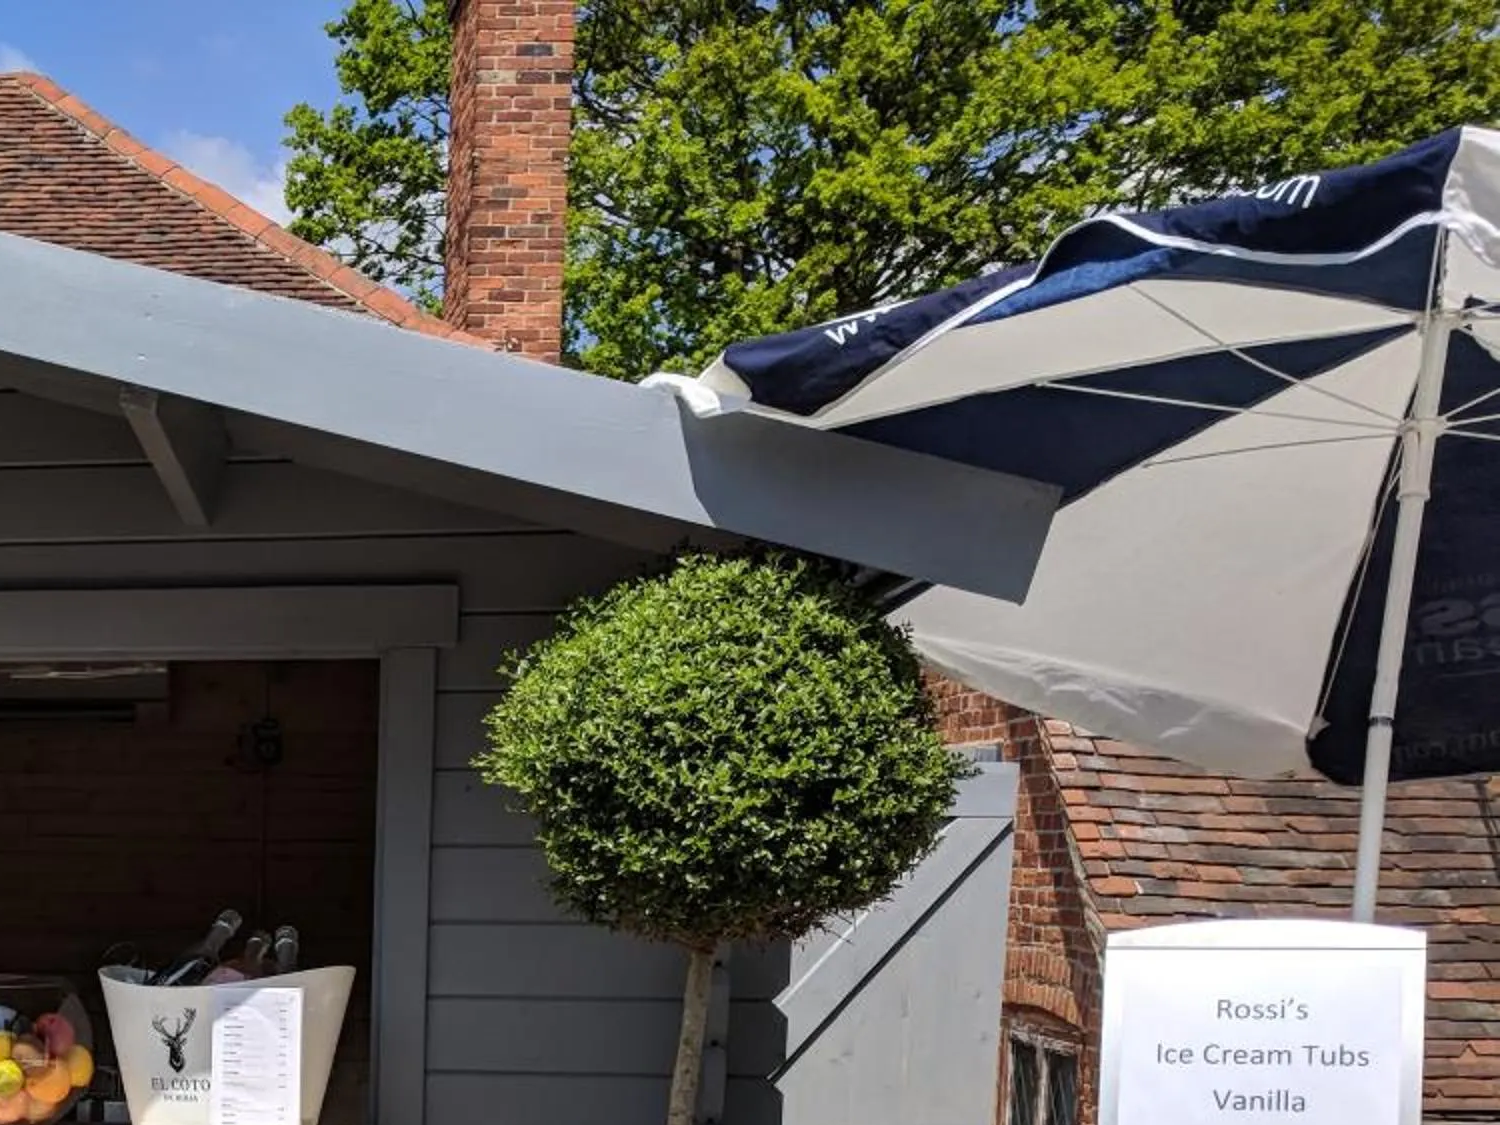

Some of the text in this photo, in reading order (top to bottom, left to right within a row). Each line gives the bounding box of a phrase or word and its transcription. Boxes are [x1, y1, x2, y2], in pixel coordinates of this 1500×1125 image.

[1215, 998, 1310, 1021] Rossi's
[1156, 1043, 1370, 1068] Ice Cream Tubs
[151, 1077, 211, 1092] EL COTO
[1212, 1089, 1306, 1113] Vanilla
